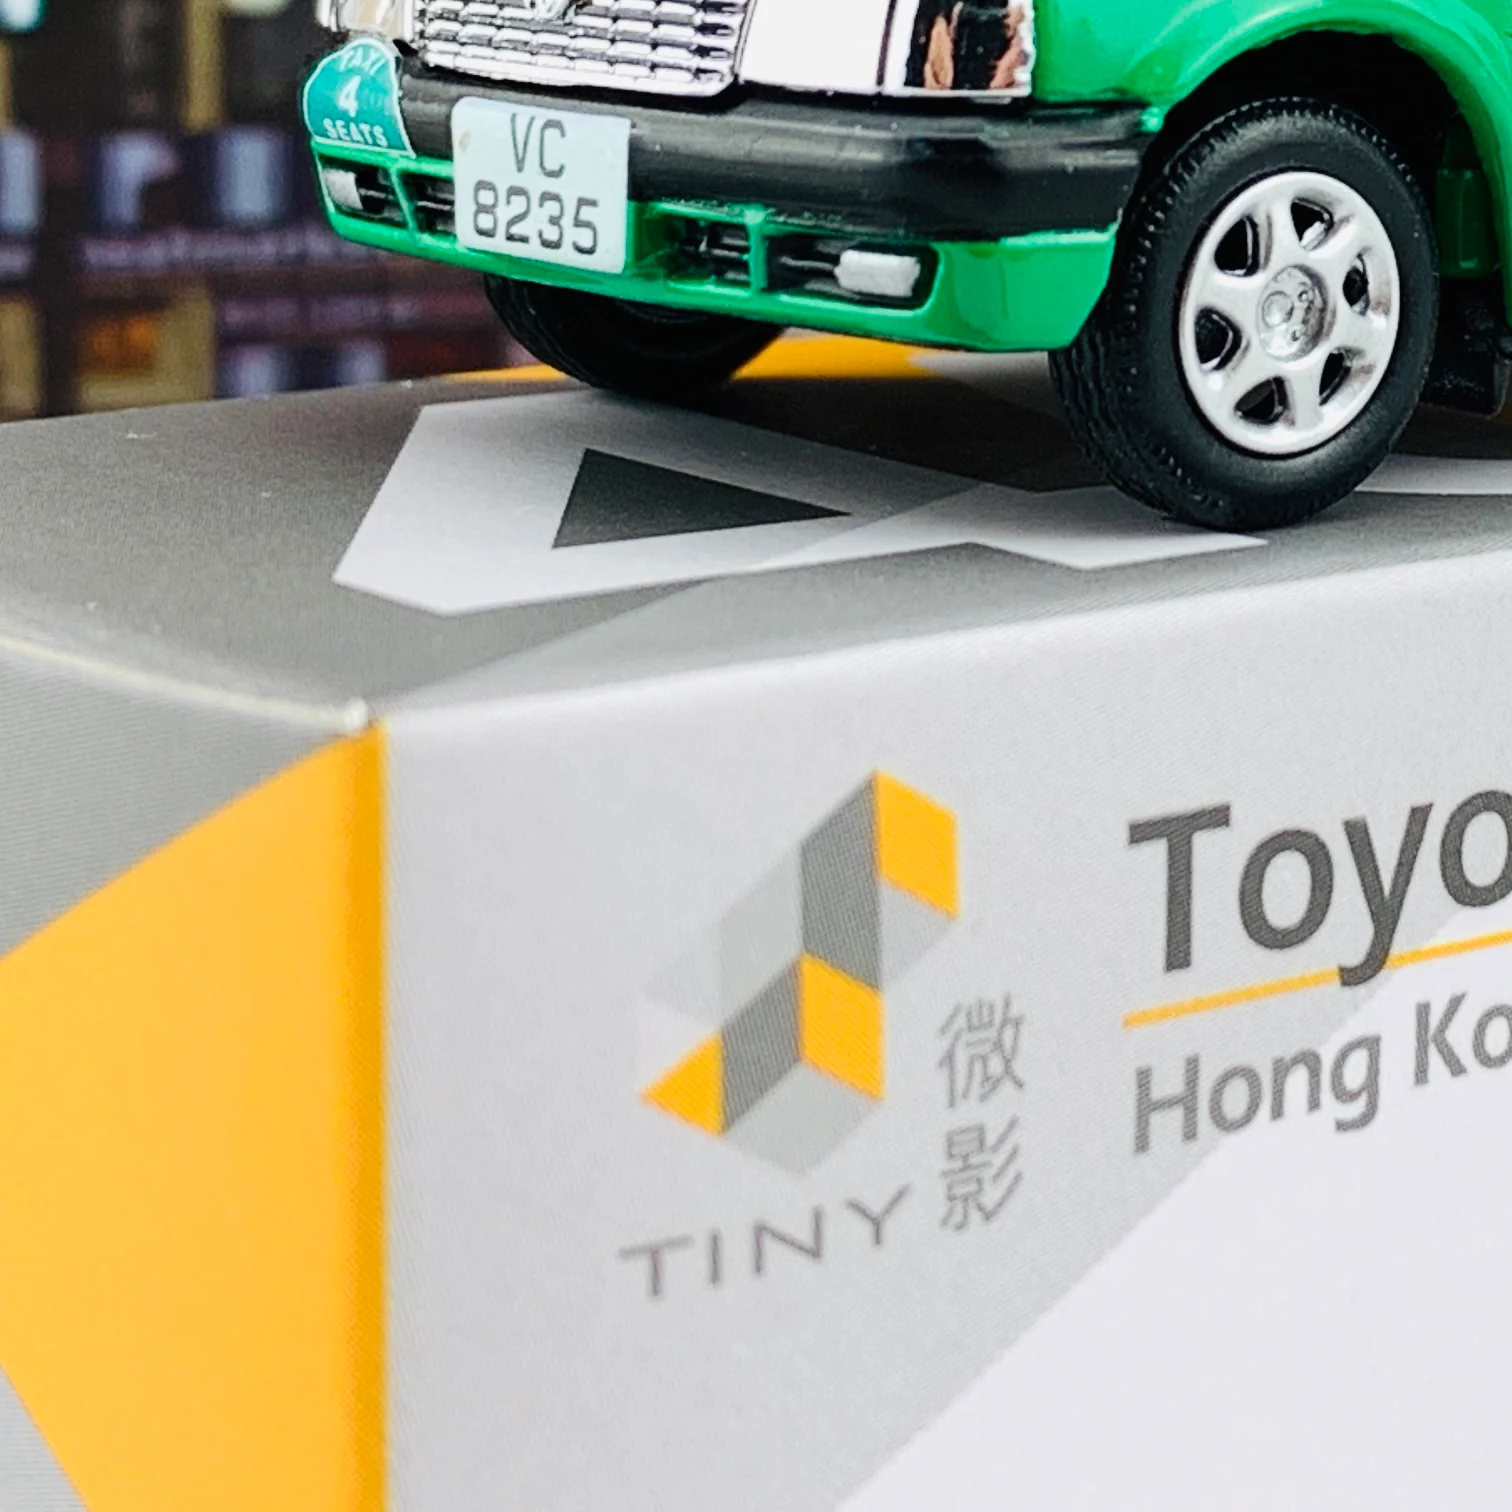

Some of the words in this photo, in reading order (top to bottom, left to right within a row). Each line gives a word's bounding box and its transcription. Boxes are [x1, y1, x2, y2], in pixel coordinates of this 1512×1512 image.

[322, 117, 390, 149] SEATS
[338, 75, 362, 118] 4
[509, 112, 567, 179] VC
[472, 179, 599, 256] 8235
[937, 990, 1027, 1232] 微影
[1132, 1033, 1382, 1155] Hong
[618, 1182, 913, 1298] TINY
